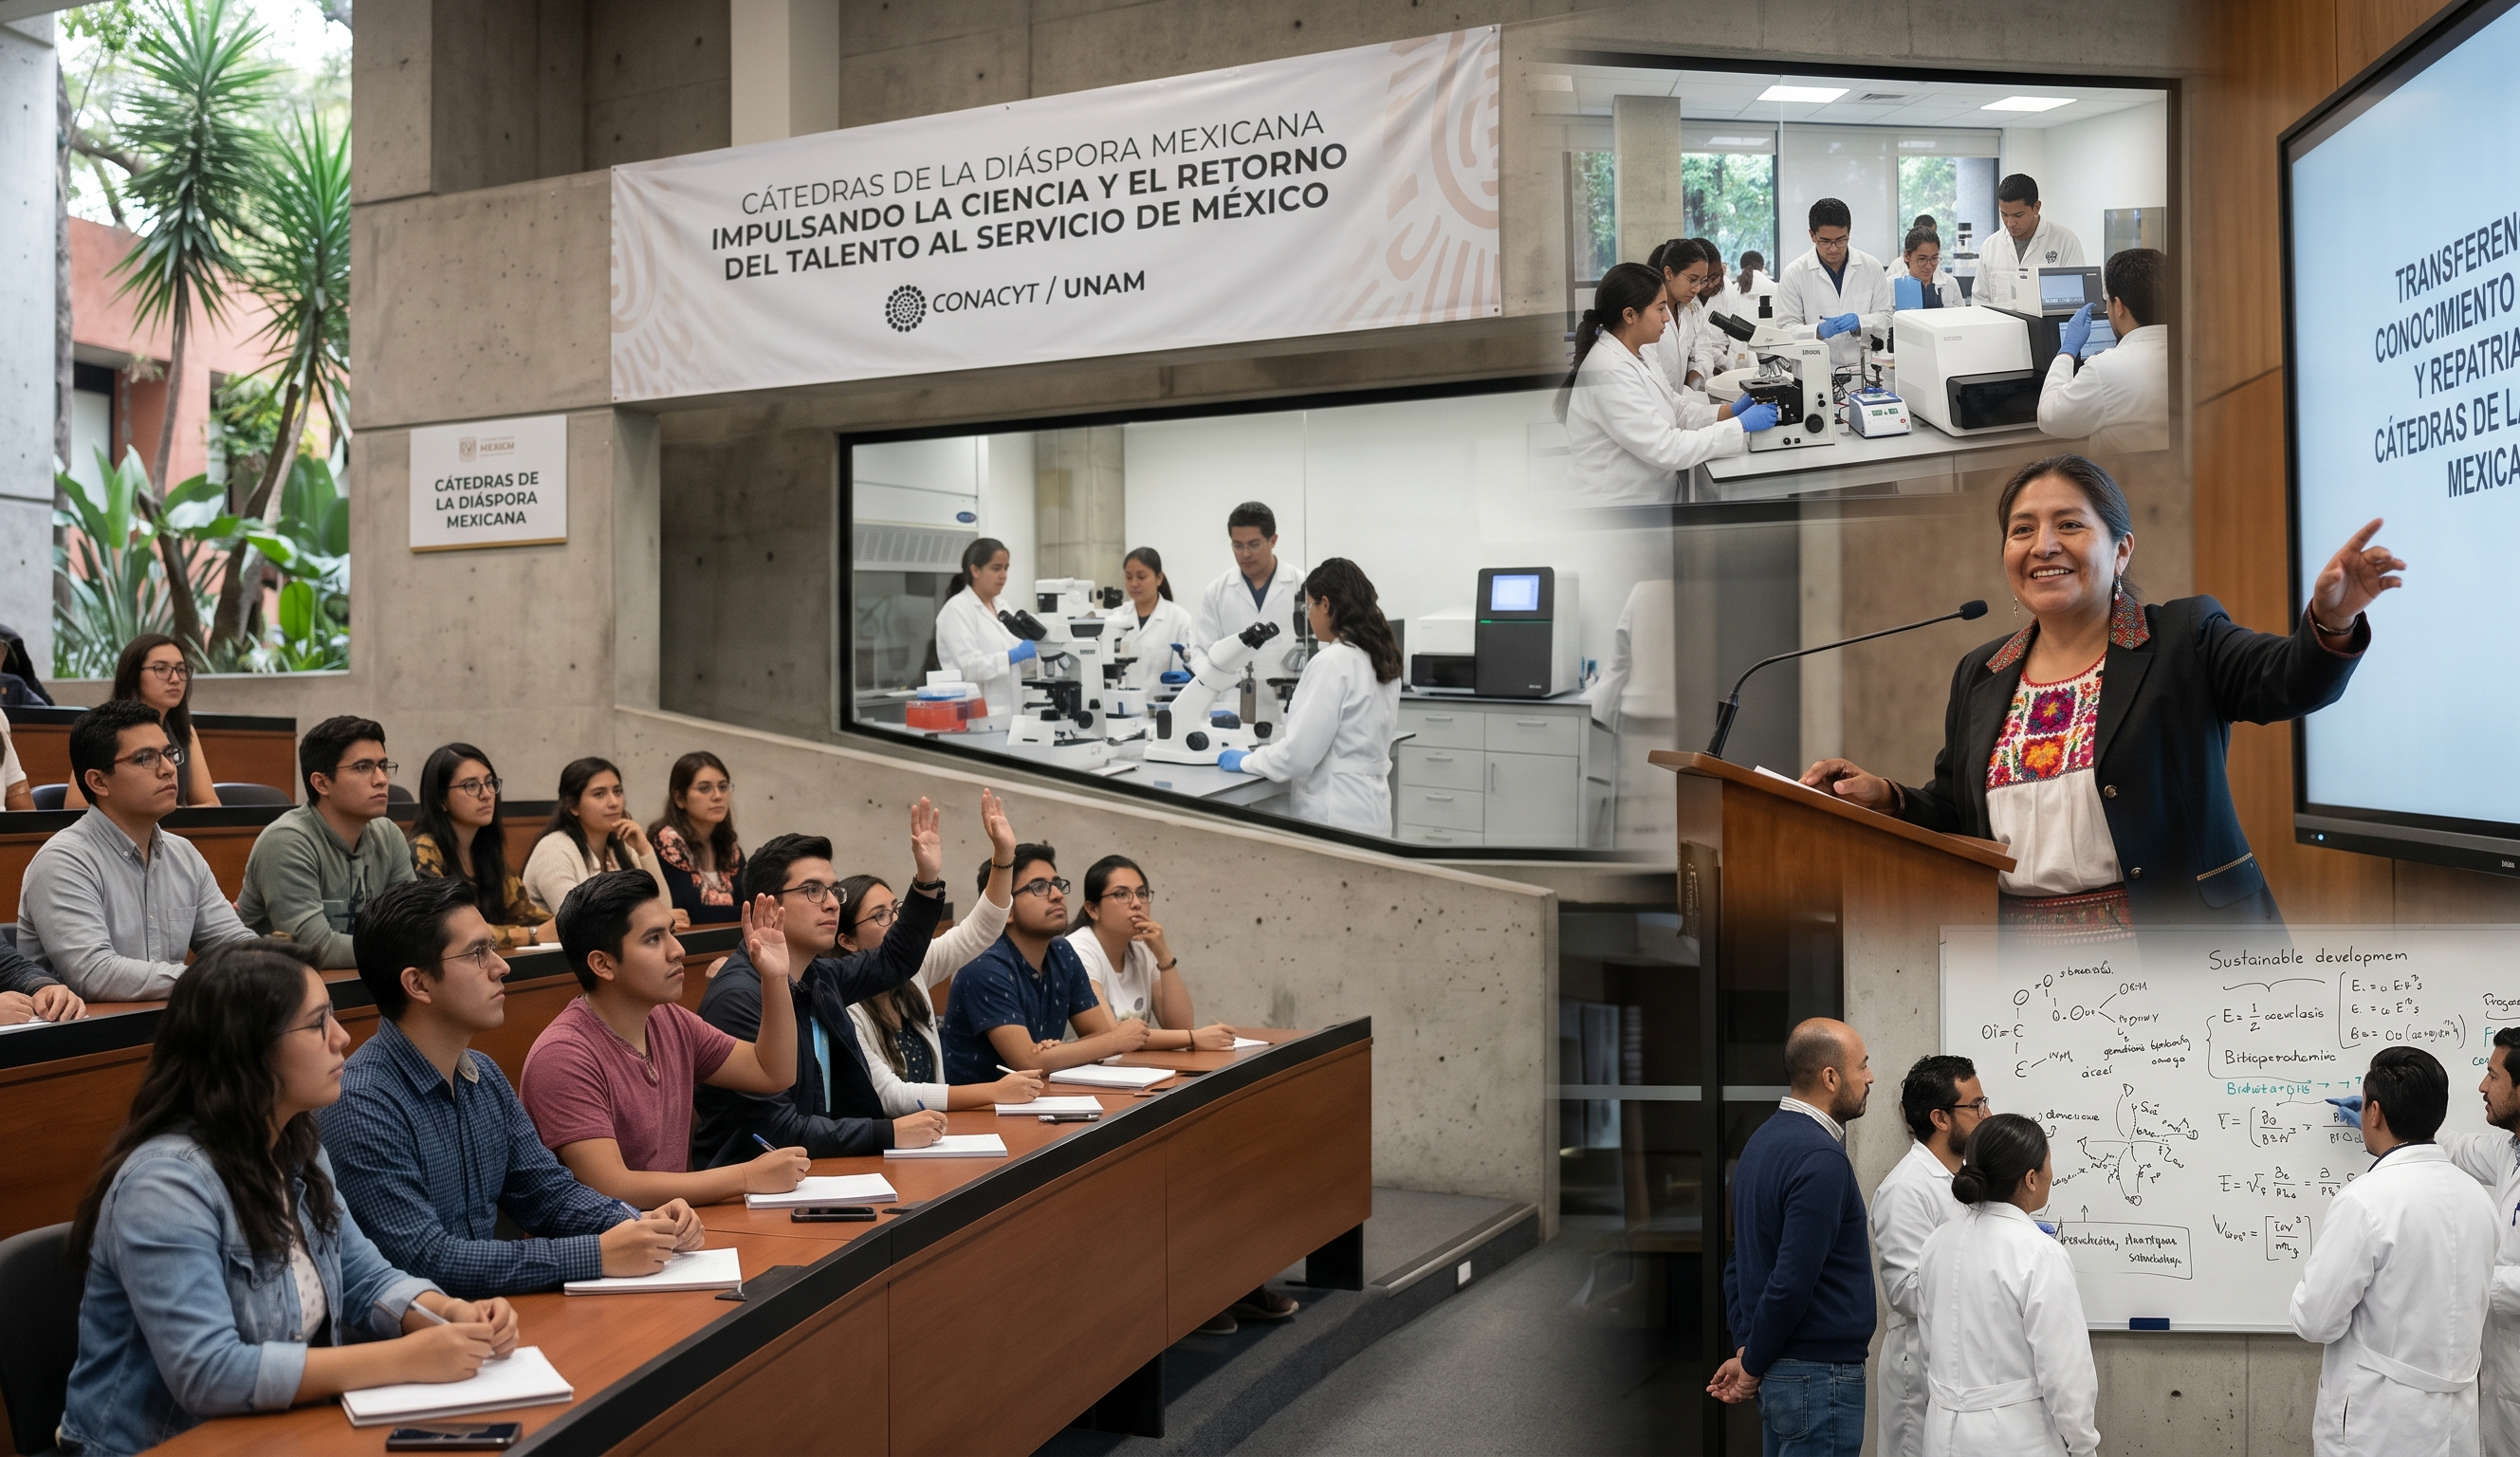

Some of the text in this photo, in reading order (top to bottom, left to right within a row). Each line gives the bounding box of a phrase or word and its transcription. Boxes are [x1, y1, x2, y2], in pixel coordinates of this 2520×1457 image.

[742, 110, 1325, 214] CÁTEDRAS DE LA DIÁSPORA MEXICANA
[712, 143, 1348, 250] IMPULSANDO LA CIENCIA Y EL RETORNO
[725, 182, 1329, 281] DEL TALENTO AL SERVICIO DE MÉXICO
[2395, 211, 2520, 304] TRANSFEREN
[932, 283, 1040, 313] CONACYT
[1064, 270, 1146, 299] UNAM
[2375, 272, 2515, 363] CONOCIMIENTO
[2414, 362, 2426, 399] Y
[2375, 388, 2520, 464] CÁTEDRAS DE L
[434, 471, 539, 492] CÁTEDRAS DE
[436, 491, 538, 511] LA DIÁSPORA
[447, 511, 526, 528] MEXICANA
[2209, 948, 2304, 969] Sustainable
